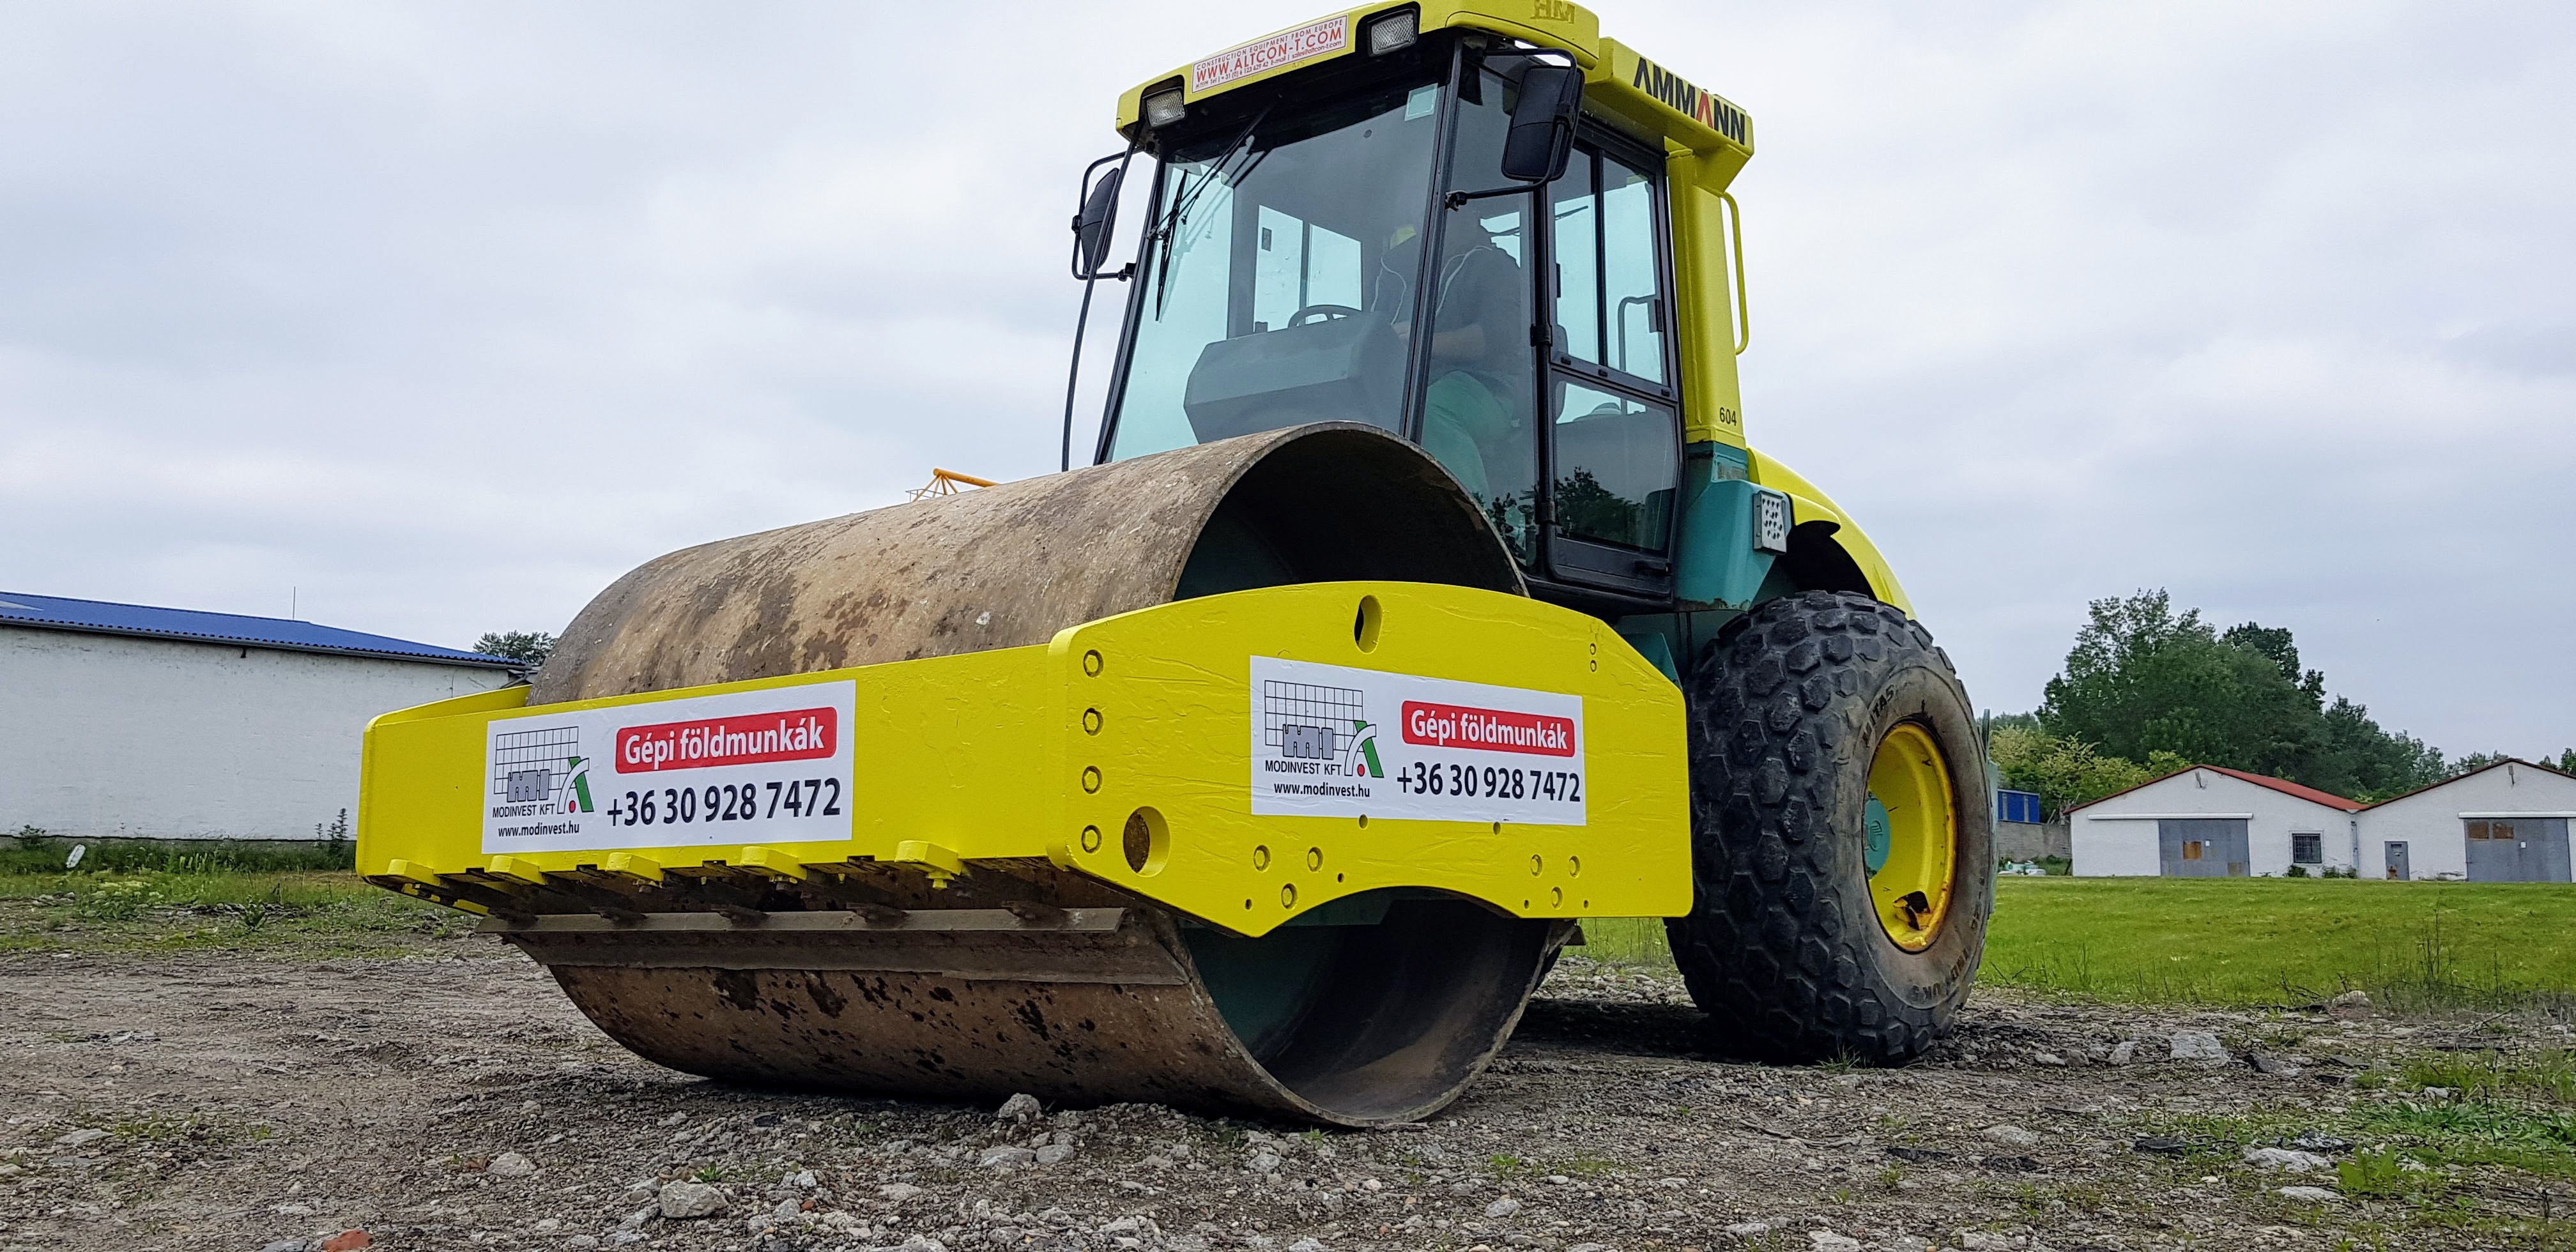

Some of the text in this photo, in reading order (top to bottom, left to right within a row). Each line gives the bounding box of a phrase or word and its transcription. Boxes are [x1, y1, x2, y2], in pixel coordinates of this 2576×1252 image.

[1196, 19, 1343, 71] CONSTRUCTION EQUIPMENT FROM EUROPE
[1196, 26, 1342, 83] WWW.ALTCON-T.COM
[1633, 56, 1745, 146] AMMANN
[1719, 406, 1737, 427] 604
[625, 716, 825, 771] Gépi földmunkák
[1411, 710, 1567, 750] Gépi földmunkák
[1264, 760, 1342, 776] MODINVEST KFT
[1397, 762, 1581, 802] +36 30 928 7472
[607, 777, 841, 827] +36 30 928 7472
[1273, 781, 1370, 798] www.modinvest.hu
[493, 803, 555, 818] MODINVEST KFT
[498, 821, 580, 837] www.modinvest.hu
